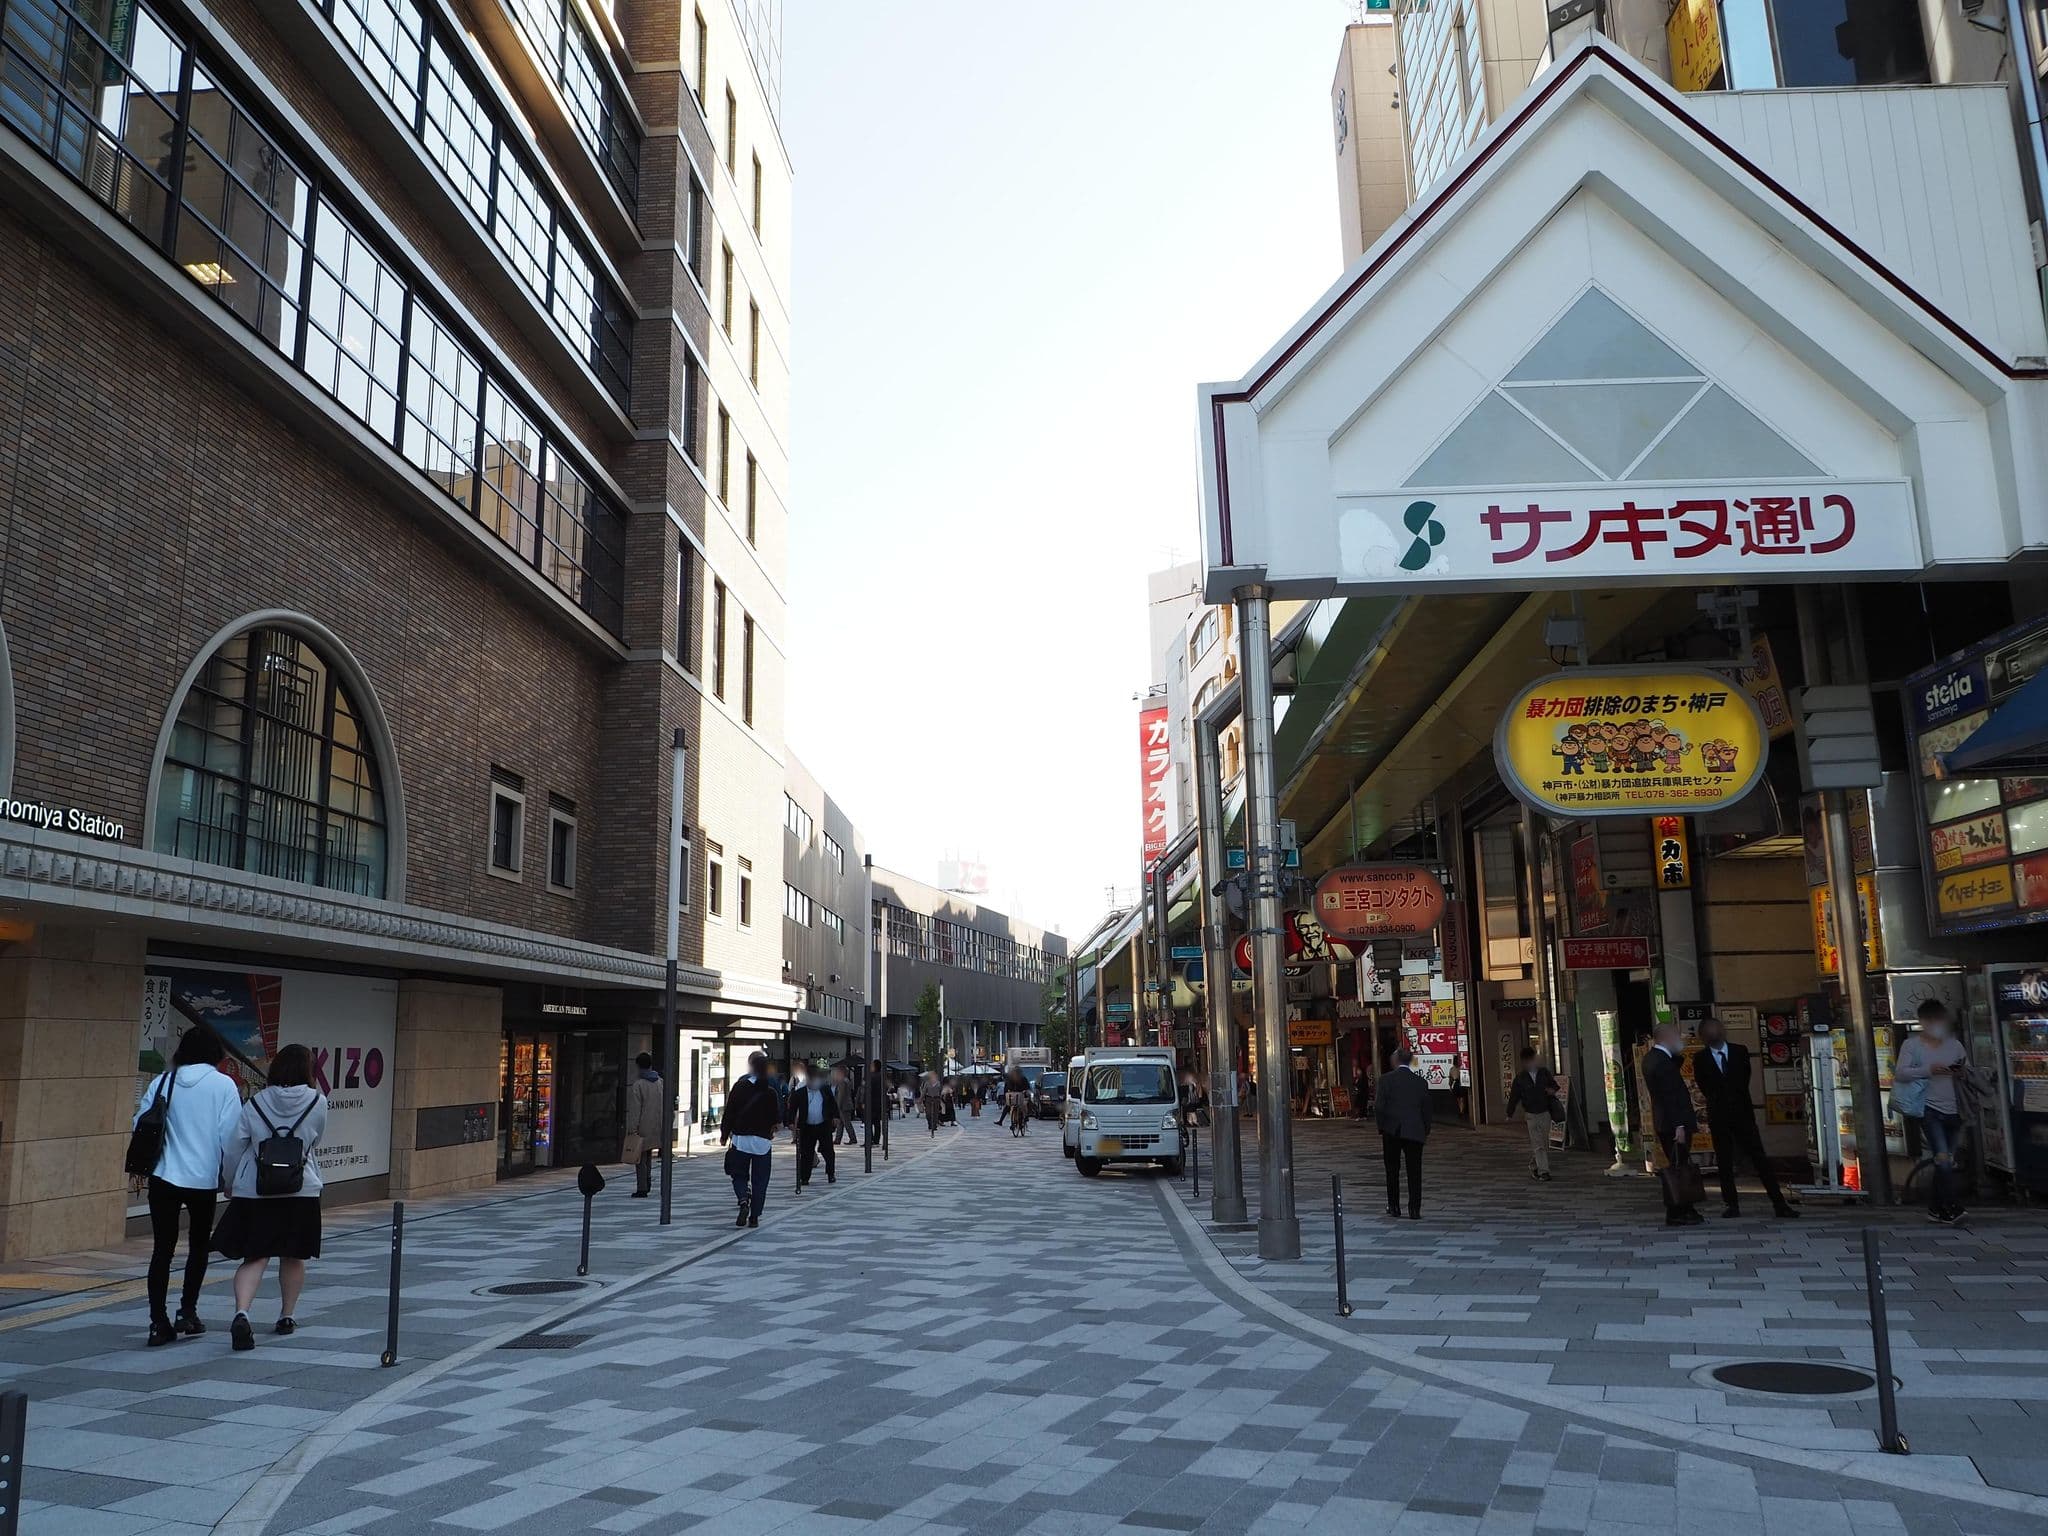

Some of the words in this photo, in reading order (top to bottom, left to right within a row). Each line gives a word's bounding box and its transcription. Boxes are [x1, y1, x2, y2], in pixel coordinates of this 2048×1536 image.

[1479, 494, 1856, 565] サンキタ通り
[1526, 692, 1728, 719] 暴力団排除のまち・神戸
[67, 808, 124, 840] Station
[1339, 872, 1416, 884] www.sancon.jp
[1343, 886, 1434, 911] 三宮コンタクト
[1410, 948, 1430, 958] KFC
[1421, 1033, 1445, 1043] KFC
